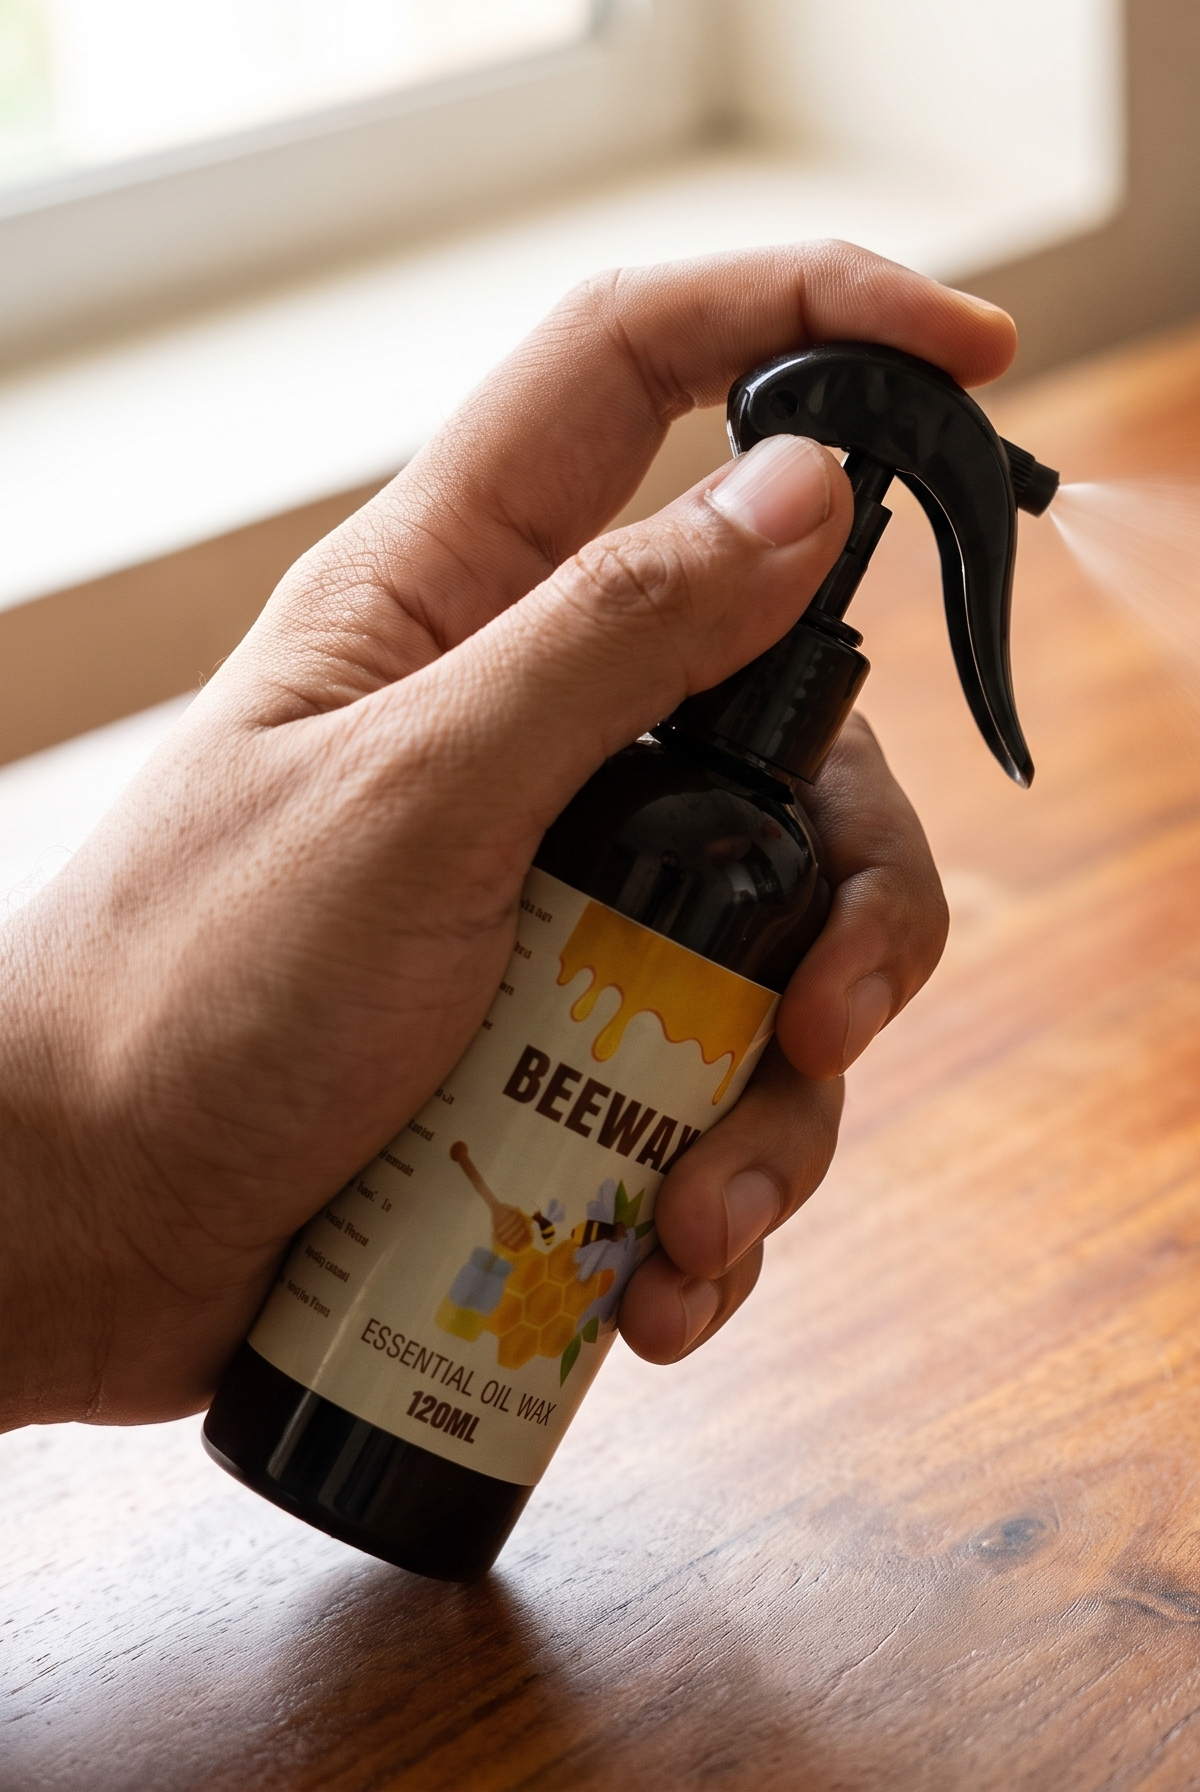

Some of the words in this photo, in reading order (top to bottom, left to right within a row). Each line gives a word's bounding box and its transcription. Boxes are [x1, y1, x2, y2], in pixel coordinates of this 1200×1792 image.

[502, 1043, 701, 1176] BEEWAX
[360, 1317, 475, 1398] ESSENTIAL
[480, 1379, 513, 1413] OIL
[516, 1392, 557, 1427] WAX
[406, 1390, 481, 1444] 120ML
